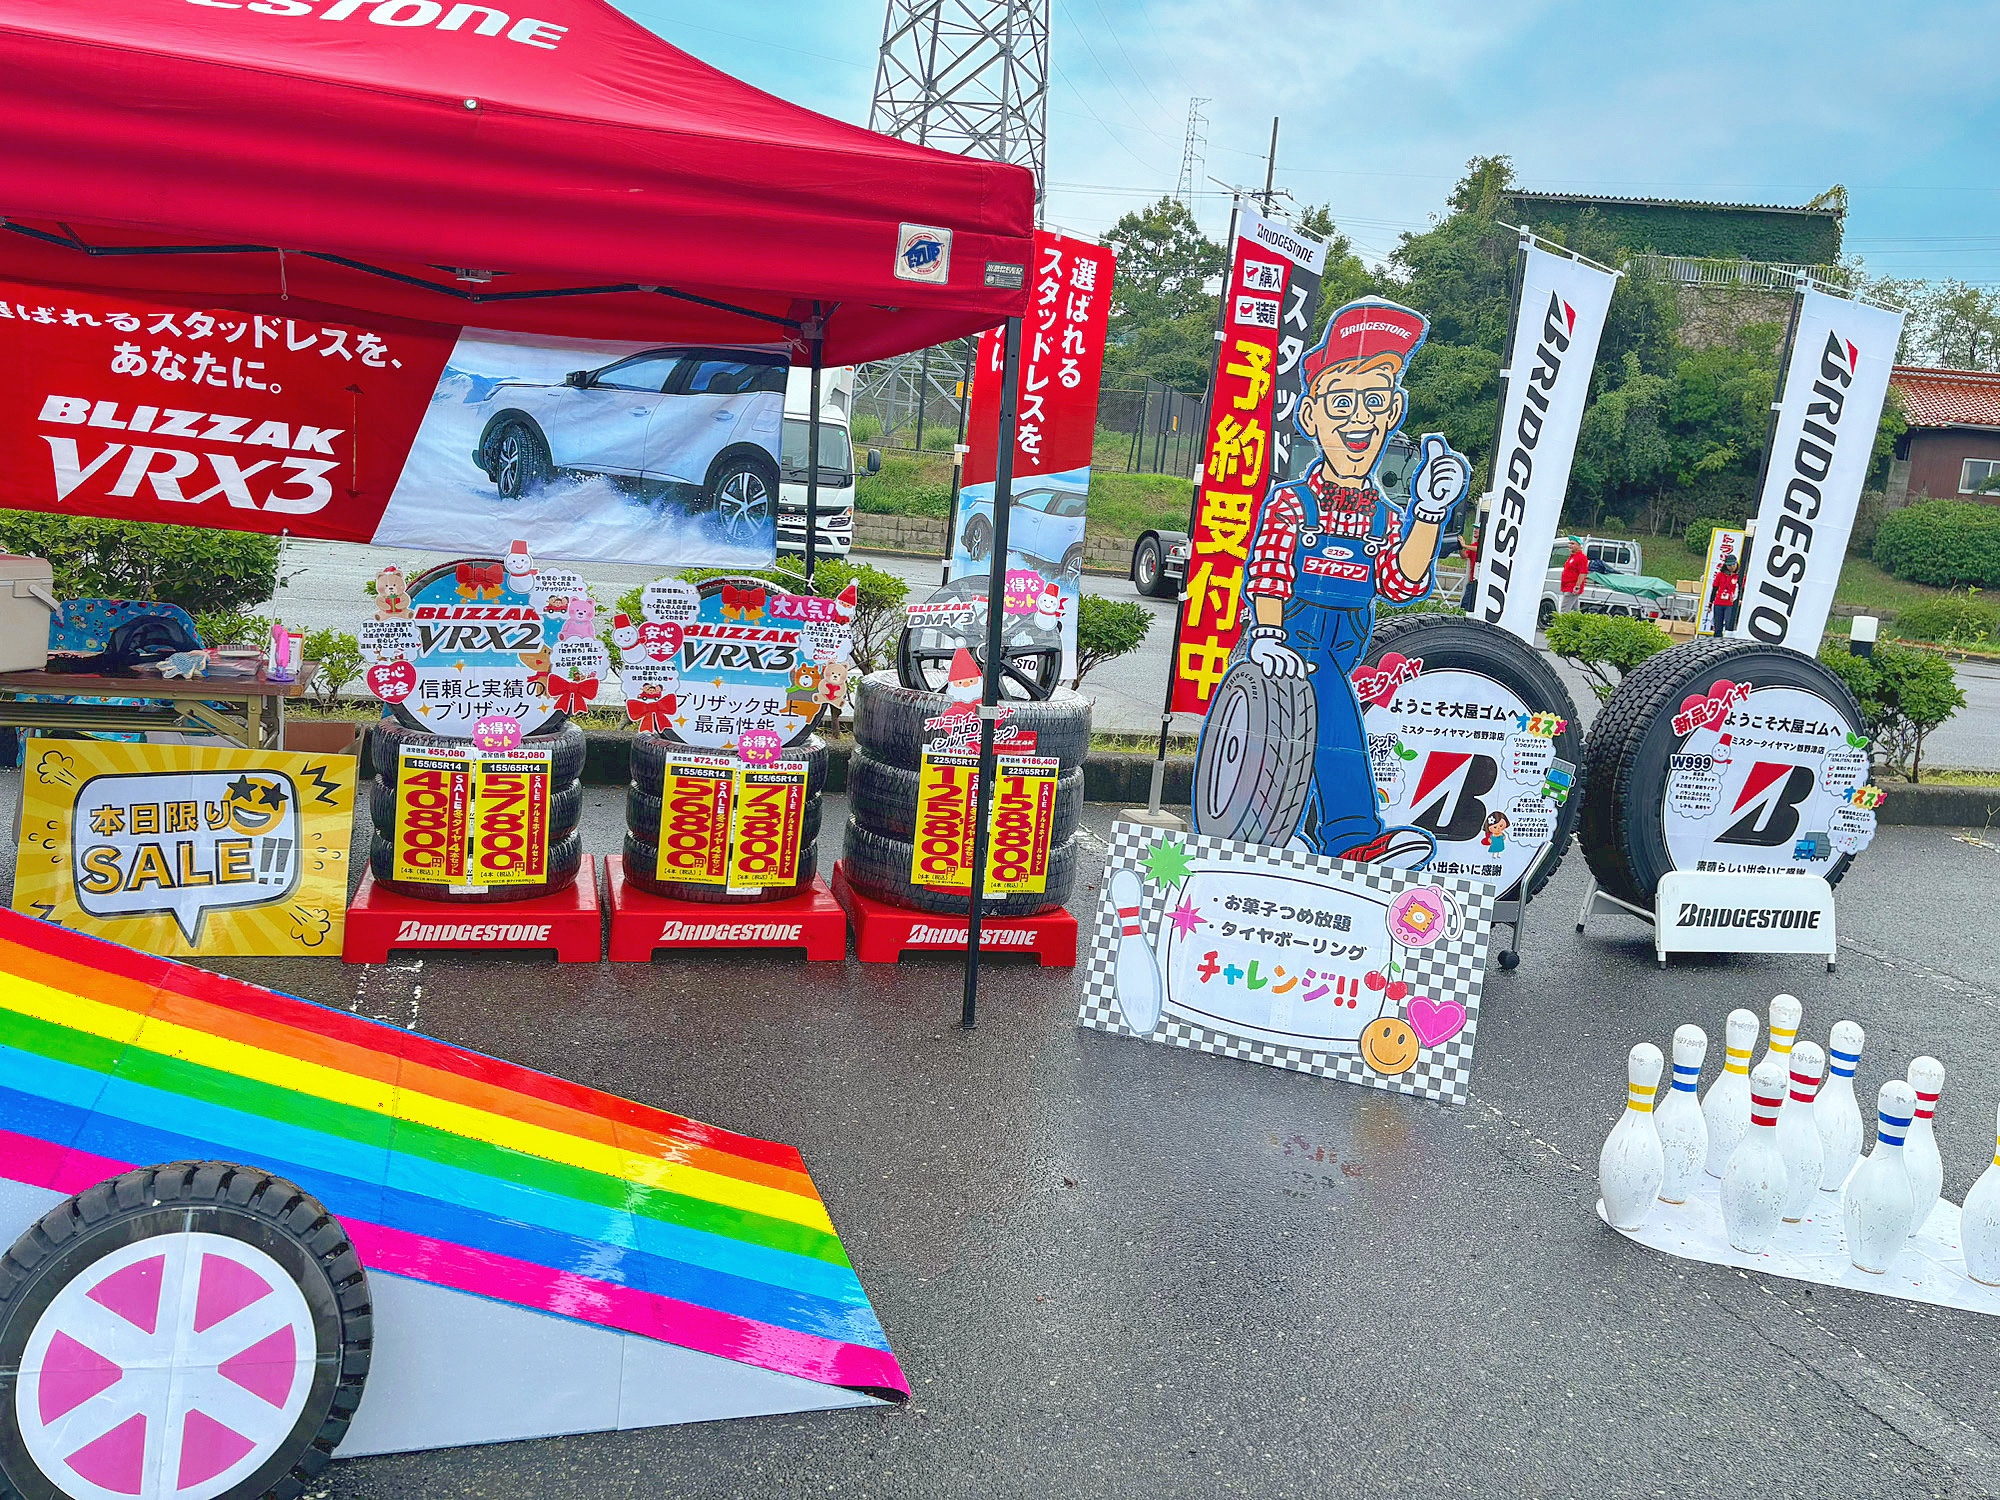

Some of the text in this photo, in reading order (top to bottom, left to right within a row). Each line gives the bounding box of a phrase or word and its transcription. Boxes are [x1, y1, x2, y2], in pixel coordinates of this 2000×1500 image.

[1257, 223, 1314, 263] BRIDGESTONE
[1259, 266, 1280, 288] 購入
[1058, 257, 1097, 388] 選ばれる
[1340, 322, 1412, 340] BRIDGESTONE
[1017, 248, 1063, 466] スタッドレスを、
[111, 341, 282, 394] あなたに。
[37, 395, 345, 455] BLIZZAK
[38, 435, 341, 515] VRX3
[1180, 340, 1272, 700] 予約受付中
[1306, 560, 1366, 578] タイヤマン
[907, 603, 973, 613] BLIZZAK
[1005, 594, 1036, 608] セット
[908, 612, 974, 626] DM-V3
[417, 624, 540, 654] VRX2
[645, 625, 674, 639] 安心
[684, 624, 800, 644] BLIZZAK
[646, 641, 676, 655] 安全
[684, 643, 798, 670] VRX3
[374, 666, 406, 683] 安心
[377, 682, 410, 698] 安全
[419, 679, 546, 699] 信頼と実績の
[435, 701, 530, 720] ブリザック
[677, 692, 800, 717] ブリザック史上
[1390, 699, 1520, 721] ようこそ大屋ゴムへ
[1673, 683, 1751, 734] 新品タイヤ
[477, 721, 516, 735] お得な
[695, 715, 775, 735] 最高性能
[953, 723, 979, 735] PLEO
[1517, 713, 1568, 735] オススメ
[1724, 712, 1841, 737] ようこそ大屋ゴムへ
[482, 736, 513, 749] セット
[742, 734, 778, 748] お得な
[427, 748, 466, 758] ¥55,080
[747, 750, 772, 760] セット
[934, 756, 979, 766] 225/65R17
[1672, 756, 1712, 769] W999
[412, 760, 462, 770] 155/65R14
[490, 764, 540, 773] 155/65R14
[678, 767, 726, 778] 155/65R14
[1008, 768, 1050, 776] 225/65R17
[533, 776, 542, 801] SALE
[752, 775, 798, 783] 155/65R14
[453, 775, 465, 809] SALE
[717, 782, 727, 814] SALE
[790, 786, 798, 810] SALE
[1041, 784, 1049, 808] SALE
[1843, 786, 1888, 806] オススメ
[89, 800, 232, 837] 本日限り
[1676, 903, 1821, 929] BRIDGESTONE
[395, 920, 552, 941] BRIDGESTONE
[659, 920, 803, 941] BRIDGESTONE
[906, 924, 1038, 946] BRIDGSTONE
